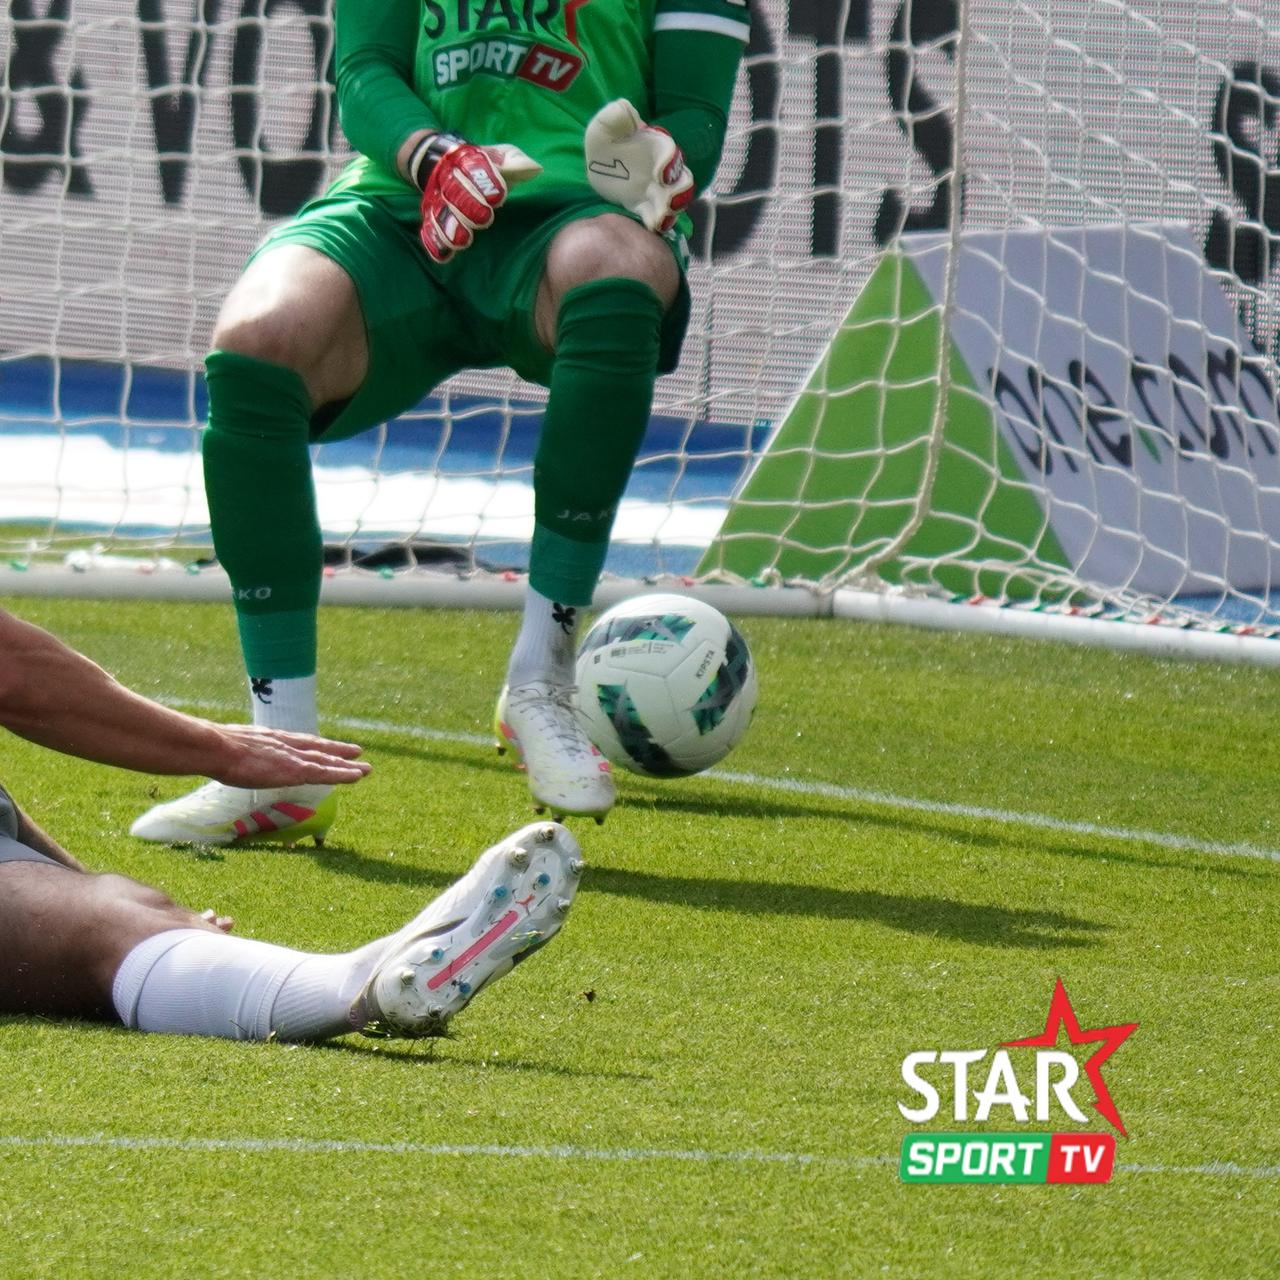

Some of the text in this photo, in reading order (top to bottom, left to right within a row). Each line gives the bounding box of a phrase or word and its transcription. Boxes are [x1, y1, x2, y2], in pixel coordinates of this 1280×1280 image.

[435, 41, 573, 85] SPORT TV
[695, 650, 715, 679] KIPSTA
